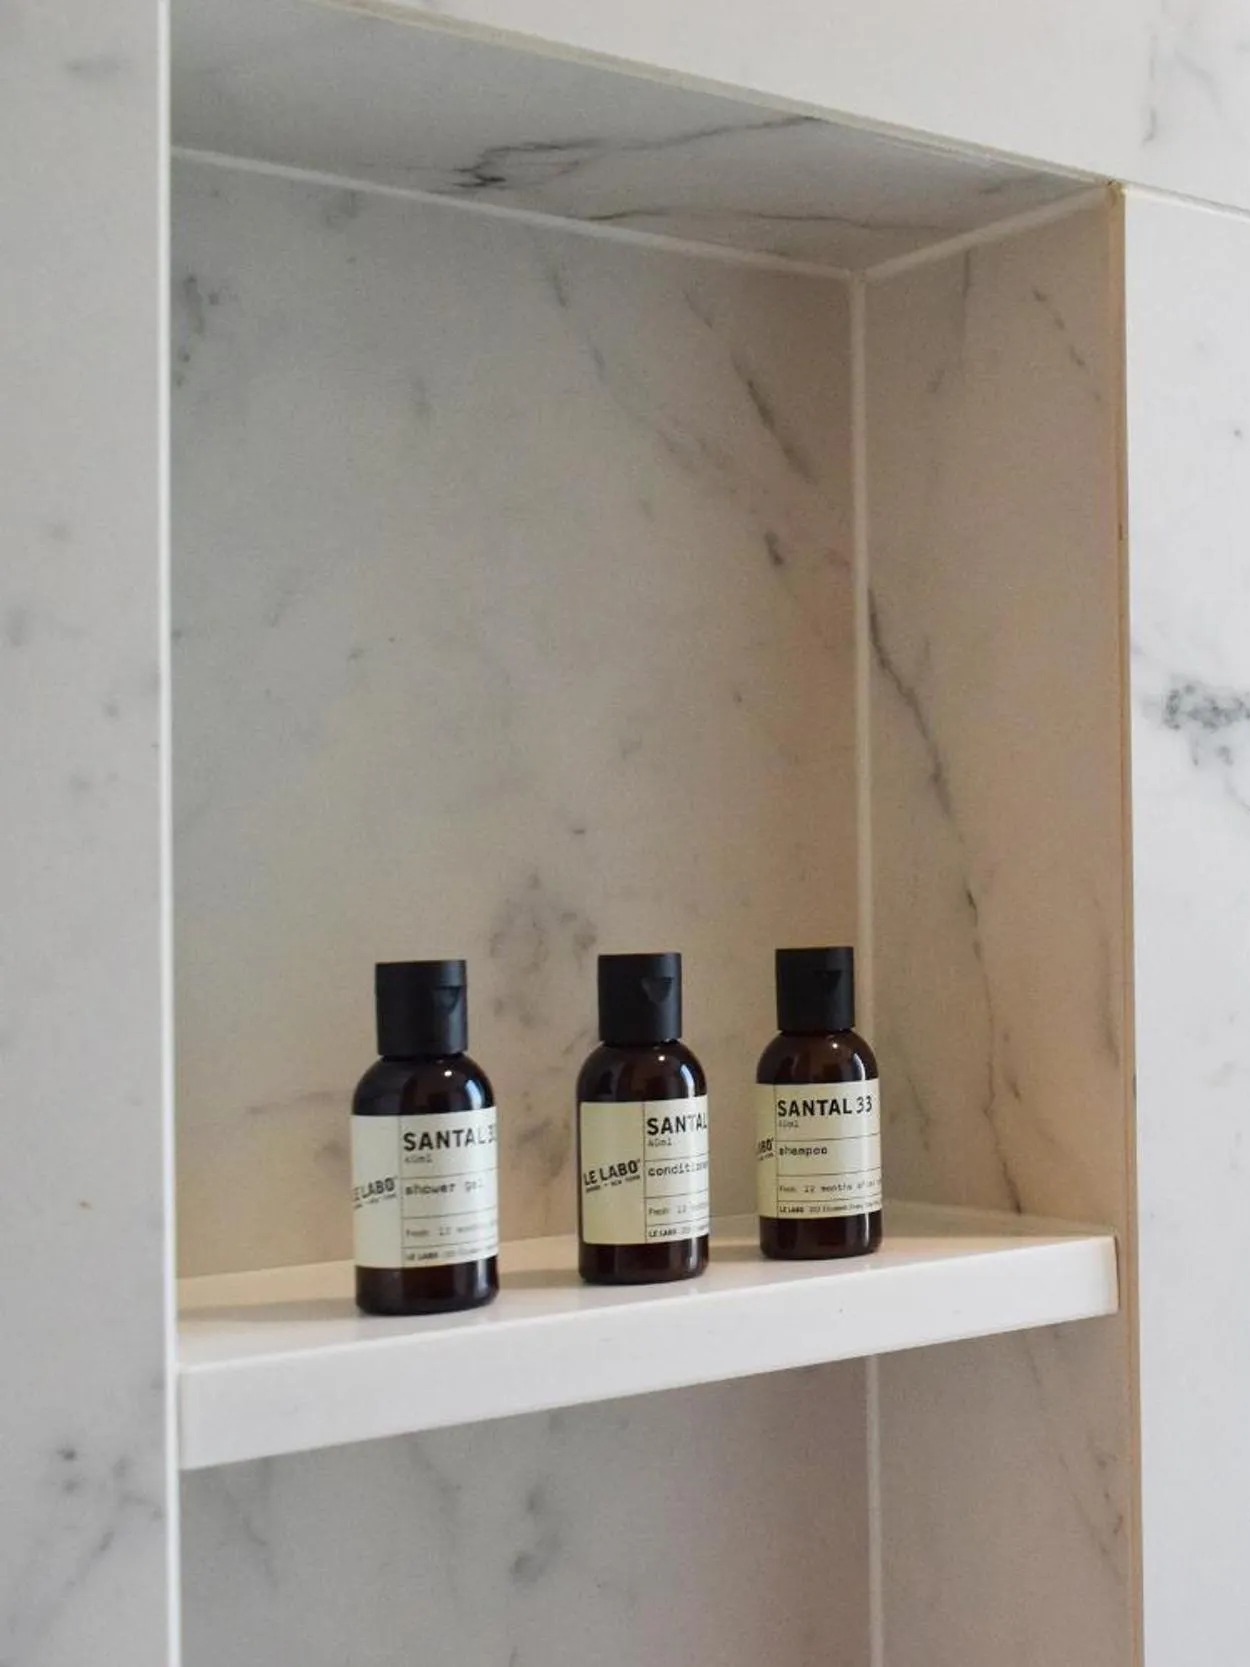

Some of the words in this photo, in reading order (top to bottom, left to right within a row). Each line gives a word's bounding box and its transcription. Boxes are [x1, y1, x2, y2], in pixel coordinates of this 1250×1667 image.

[777, 1098, 853, 1117] SANTAL
[856, 1095, 873, 1114] 33
[646, 1111, 708, 1136] SANTAL
[403, 1127, 485, 1151] SANTAL
[648, 1137, 673, 1147] 40ml
[779, 1145, 828, 1157] shampoo
[583, 1169, 598, 1186] LE
[599, 1160, 638, 1181] LABO
[360, 1176, 396, 1198] LABO
[405, 1182, 456, 1196] shower
